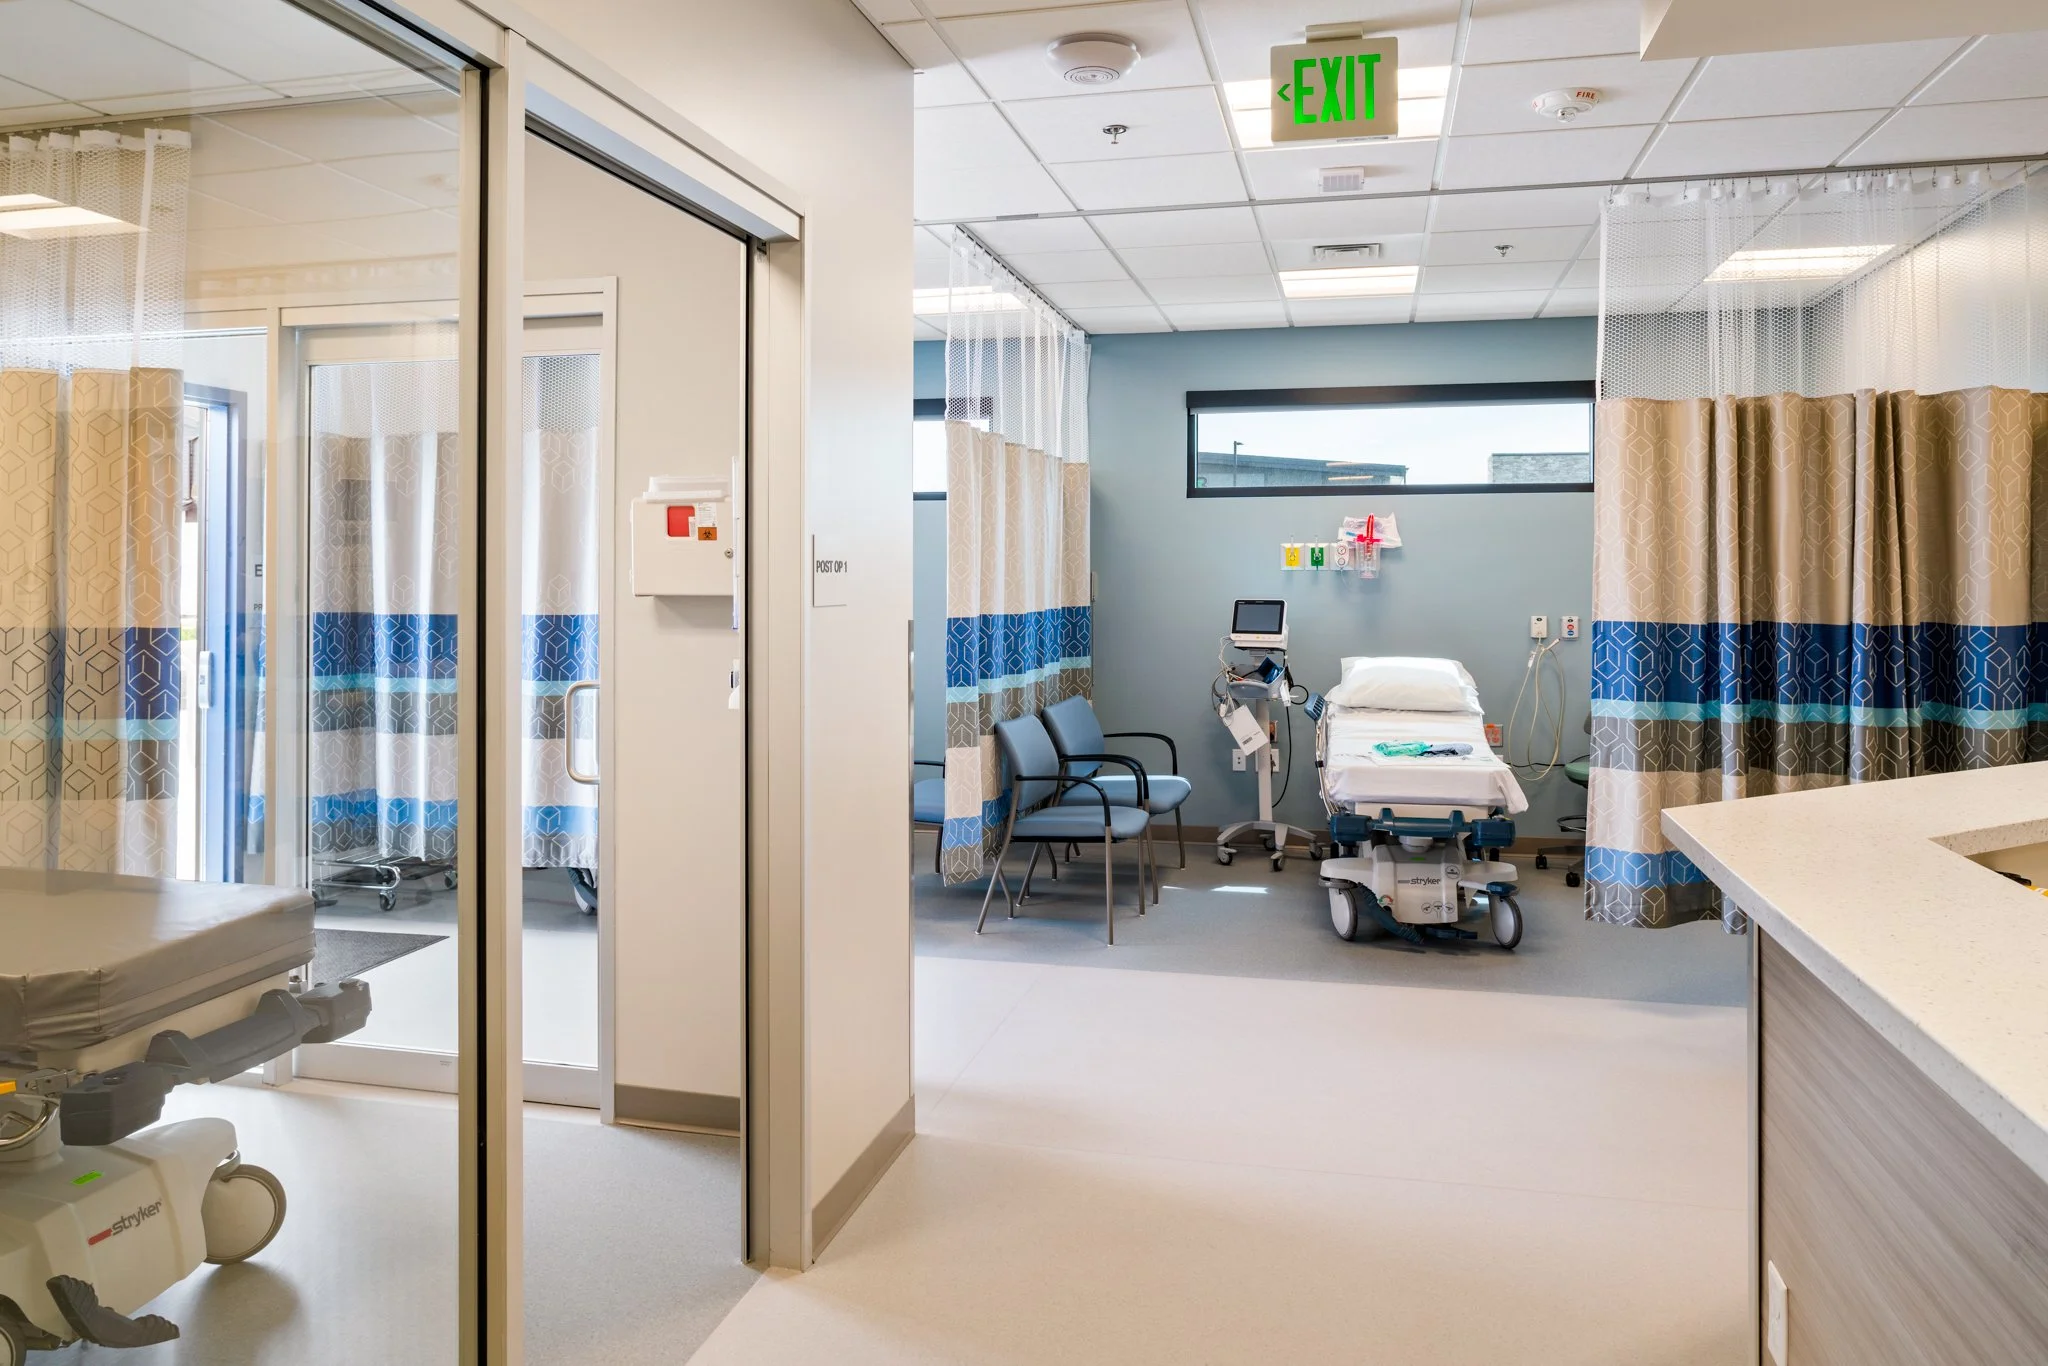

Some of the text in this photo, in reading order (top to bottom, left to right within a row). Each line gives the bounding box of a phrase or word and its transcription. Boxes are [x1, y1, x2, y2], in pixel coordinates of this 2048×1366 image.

[1293, 53, 1381, 125] EXIT
[1575, 91, 1596, 100] FIRE
[816, 560, 833, 573] POST
[834, 560, 843, 573] OP
[1410, 877, 1441, 886] stryker
[112, 1200, 162, 1236] stryker
